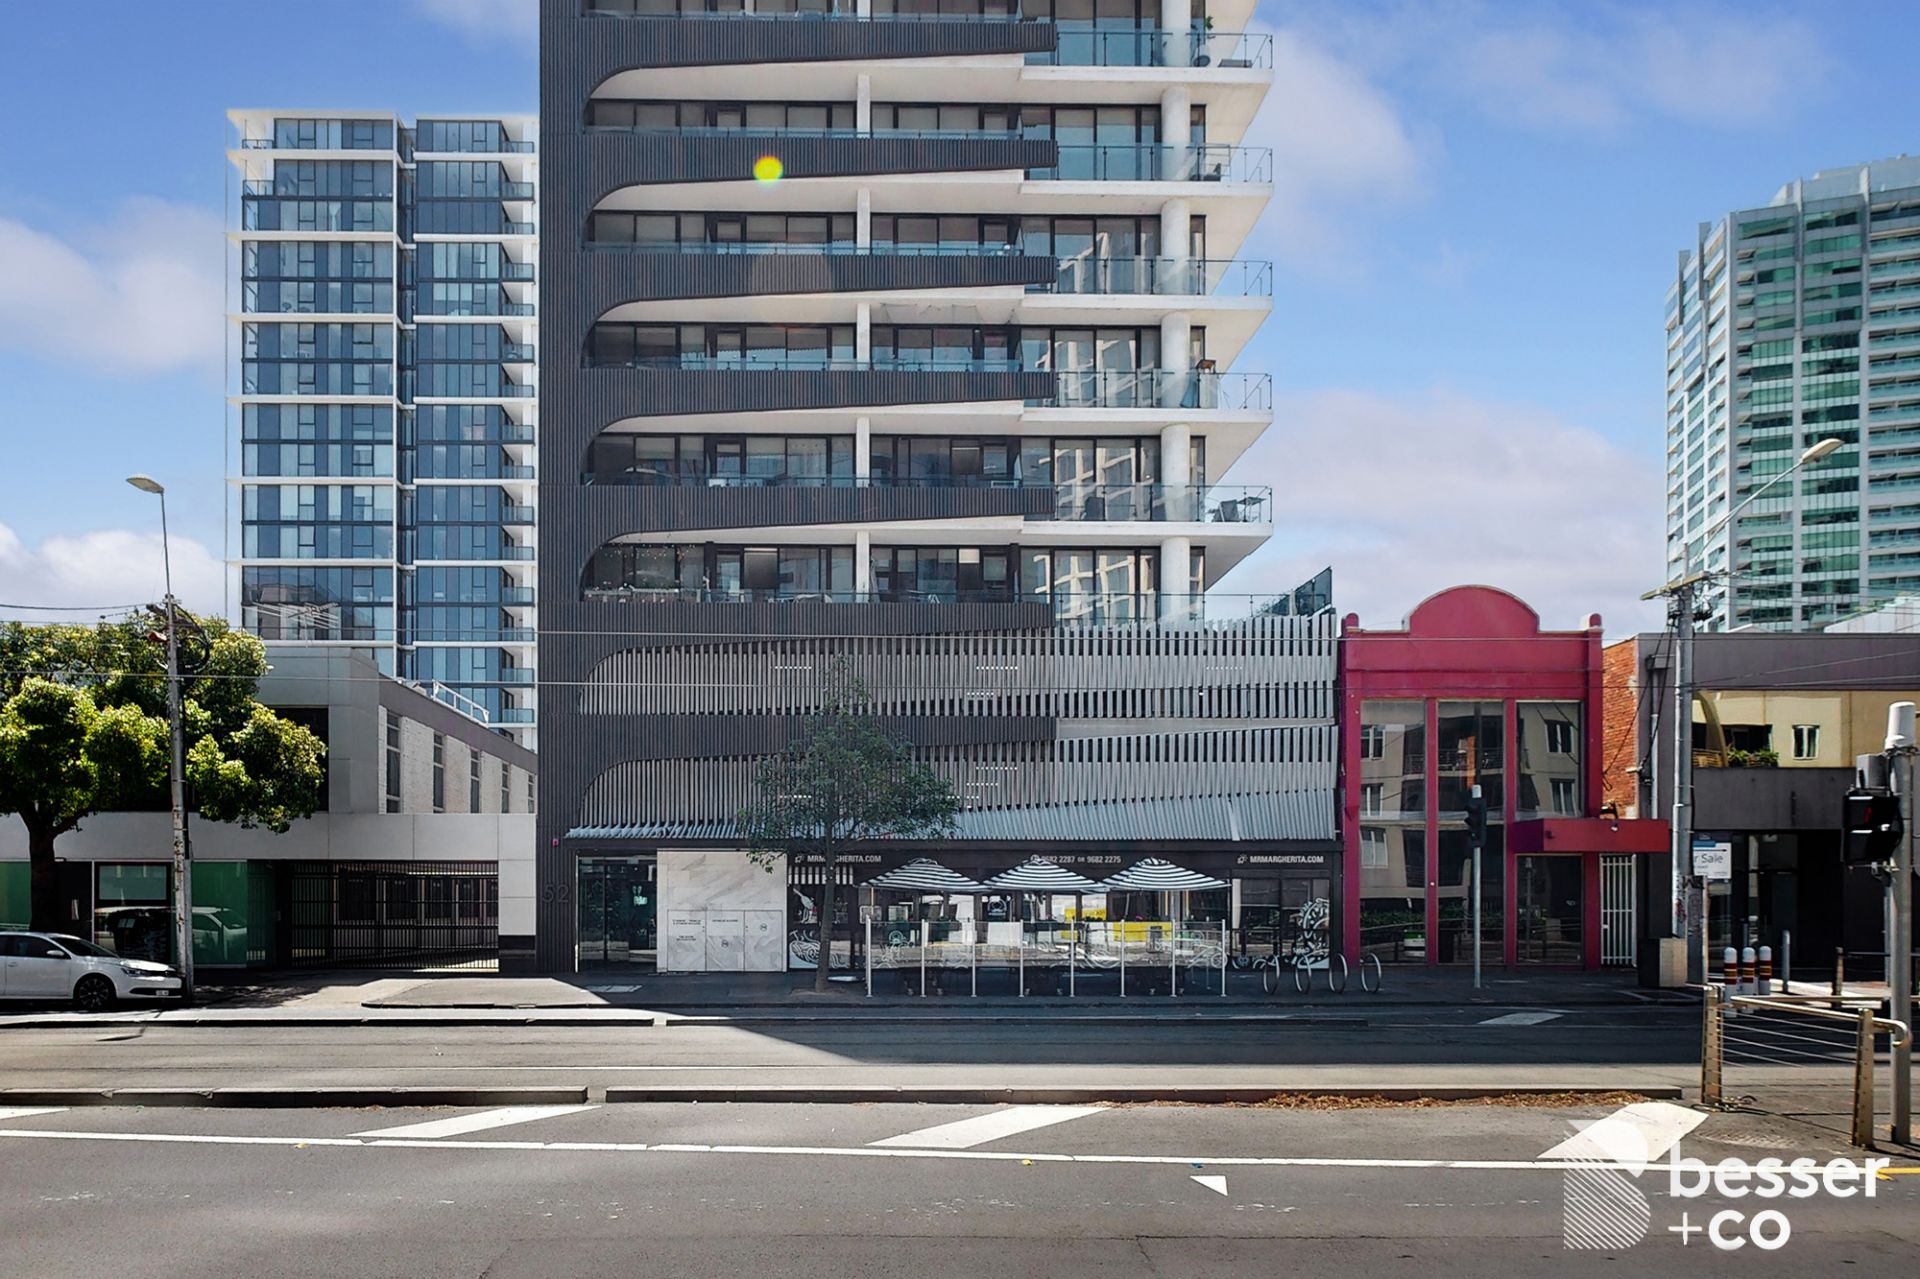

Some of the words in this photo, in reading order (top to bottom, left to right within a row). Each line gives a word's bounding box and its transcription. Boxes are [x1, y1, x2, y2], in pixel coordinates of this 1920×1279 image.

[807, 855, 882, 863] MRMGHERITA.COM
[1249, 855, 1324, 864] MRMARGHERITA.COM
[1701, 853, 1724, 864] Sale
[543, 884, 569, 903] 52
